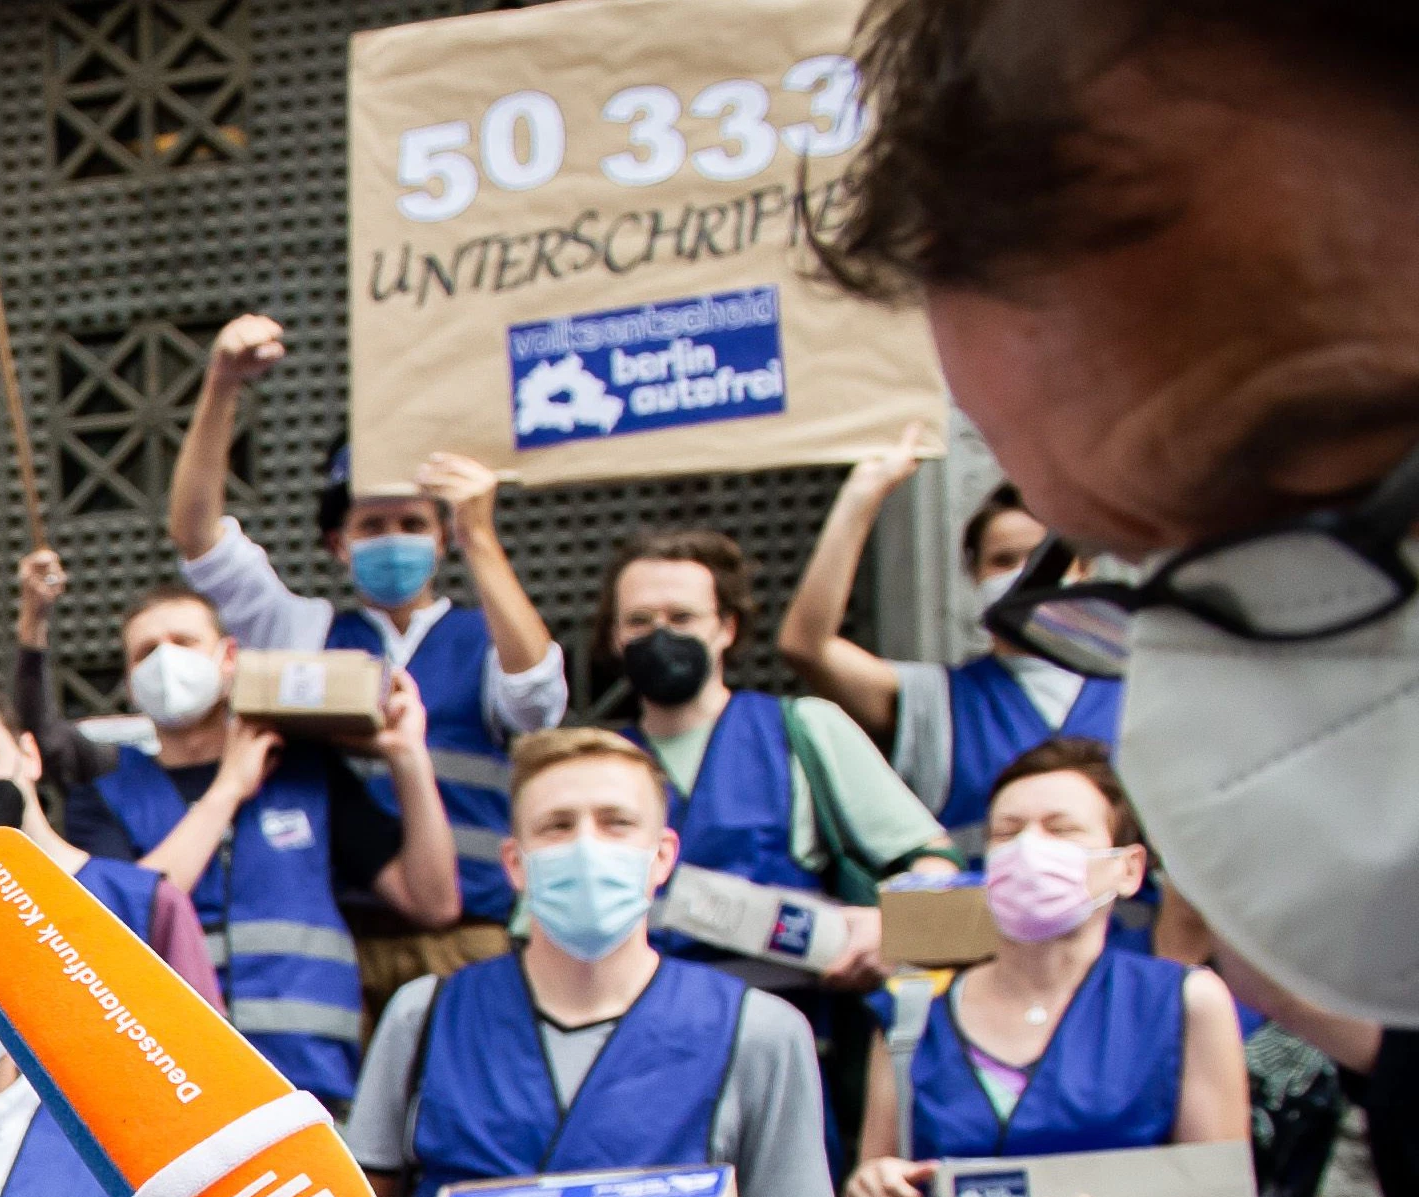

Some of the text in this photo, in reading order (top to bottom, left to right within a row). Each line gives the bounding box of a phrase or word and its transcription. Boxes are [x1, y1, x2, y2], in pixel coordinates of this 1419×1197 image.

[397, 53, 869, 222] 50 333
[369, 174, 863, 304] UNTERSCHRIFTE
[513, 284, 777, 360] volksentscheid
[609, 337, 716, 387] berlin
[628, 357, 784, 416] autofrei
[37, 923, 204, 1104] Deutschlandfunk
